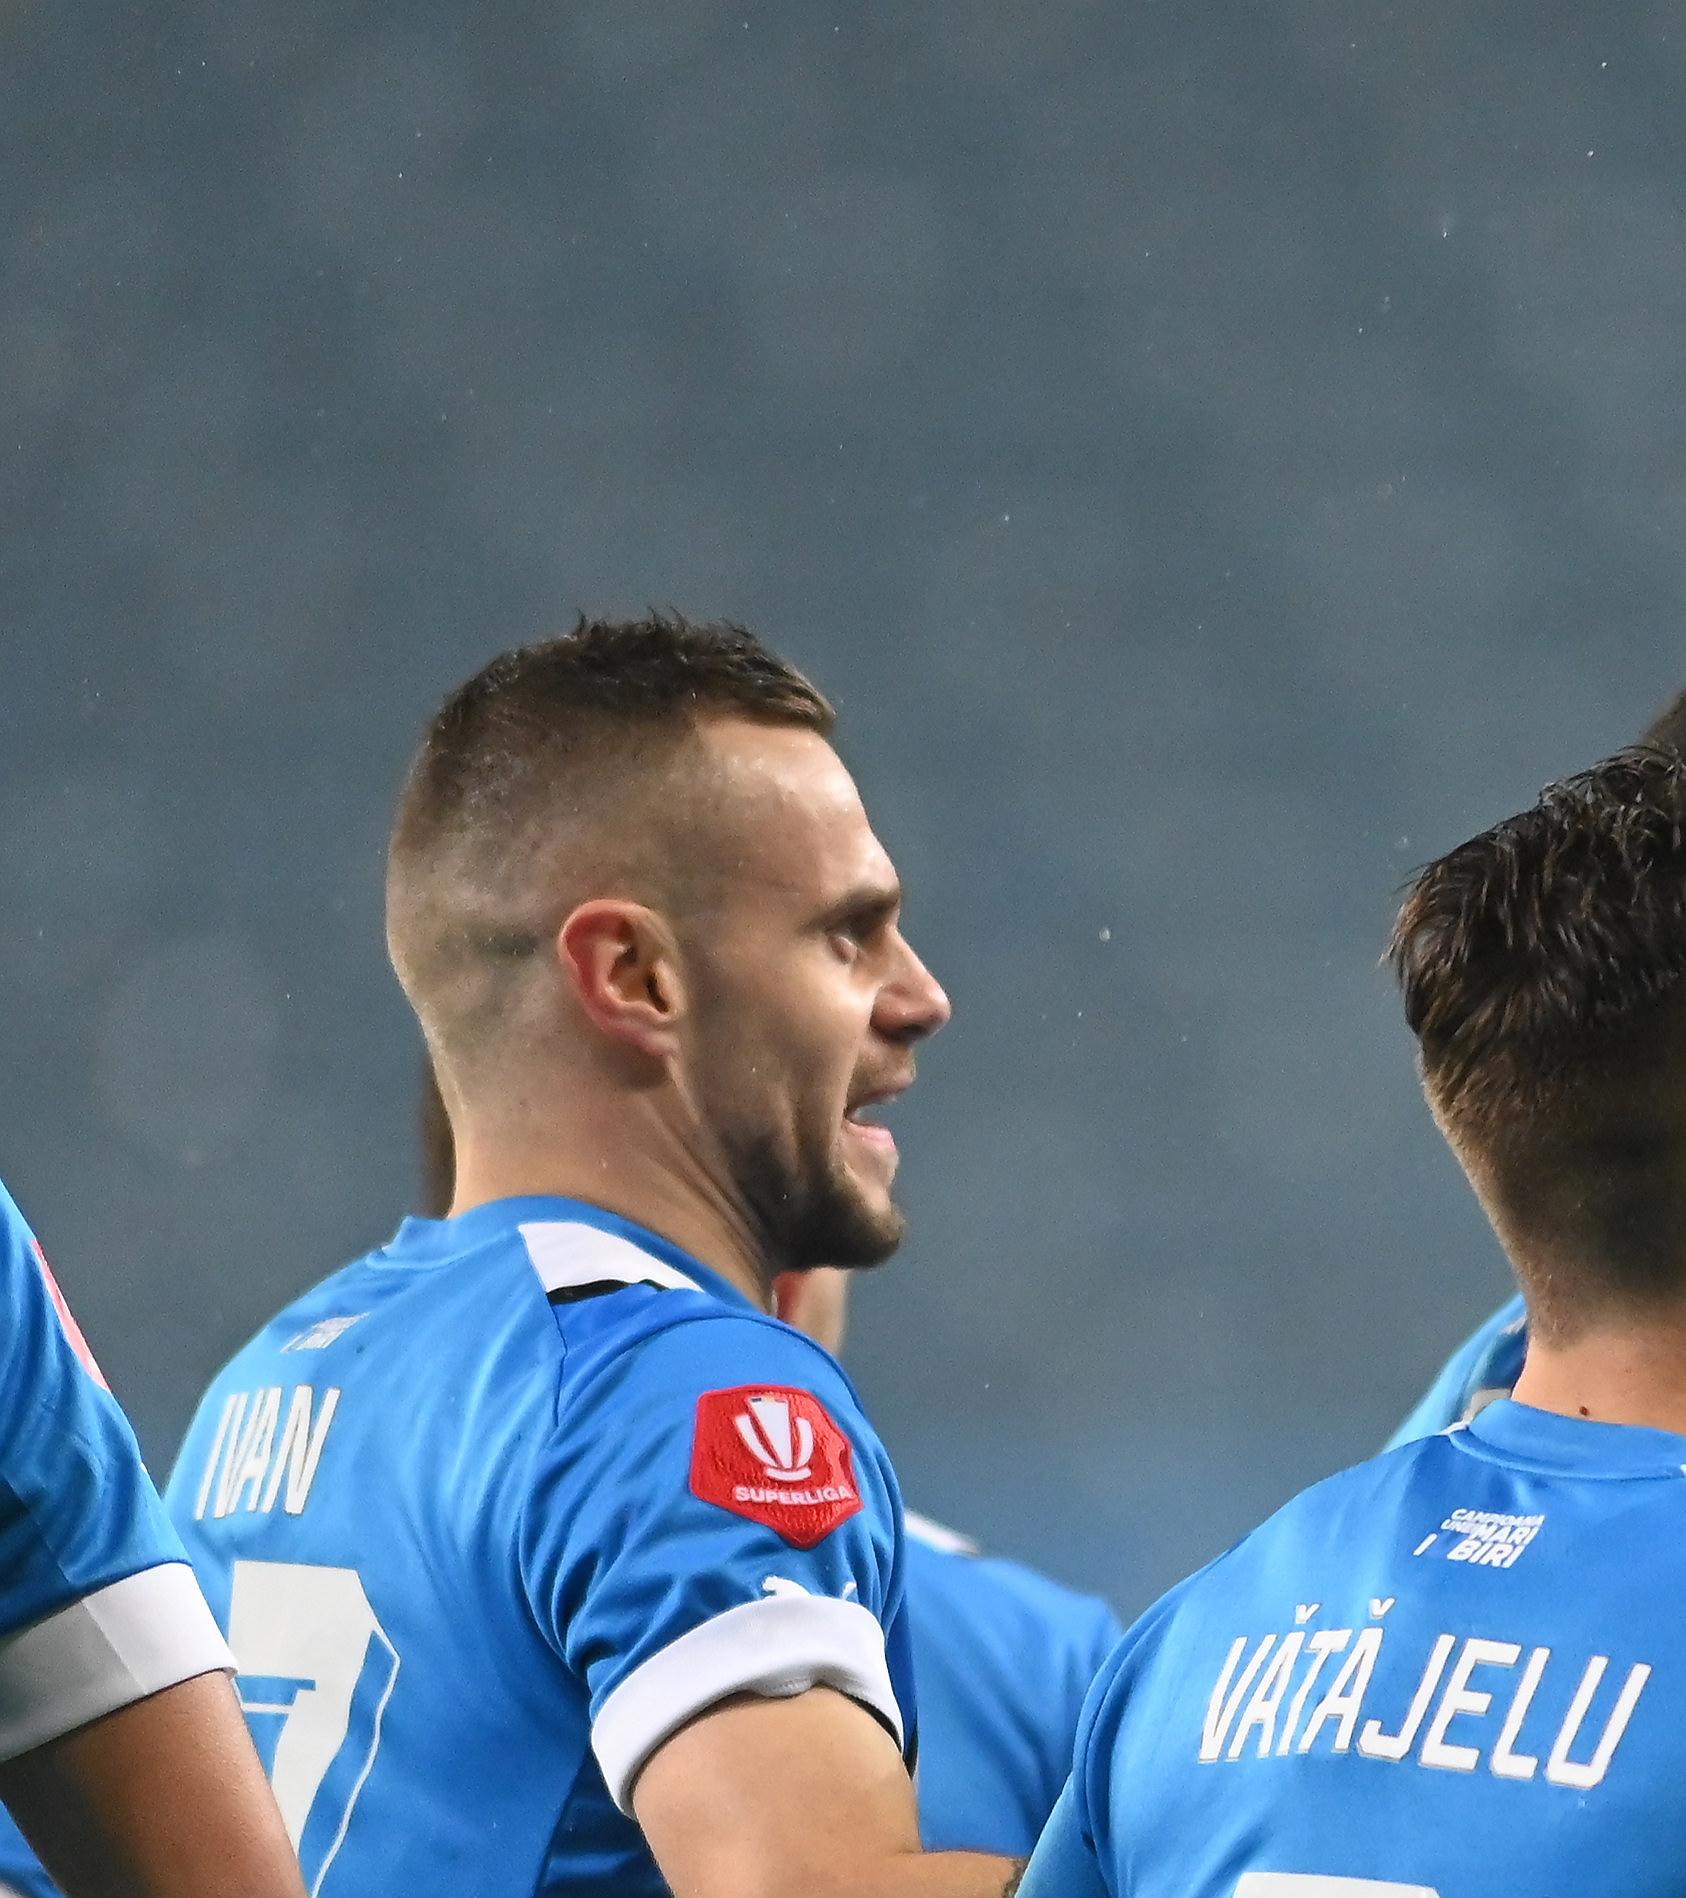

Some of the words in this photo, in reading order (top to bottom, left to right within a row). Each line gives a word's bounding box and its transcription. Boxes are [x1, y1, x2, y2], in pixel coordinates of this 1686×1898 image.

[194, 1383, 342, 1520] IVAN
[734, 1484, 854, 1505] SUPERLIGA
[1467, 1524, 1541, 1546] MARI
